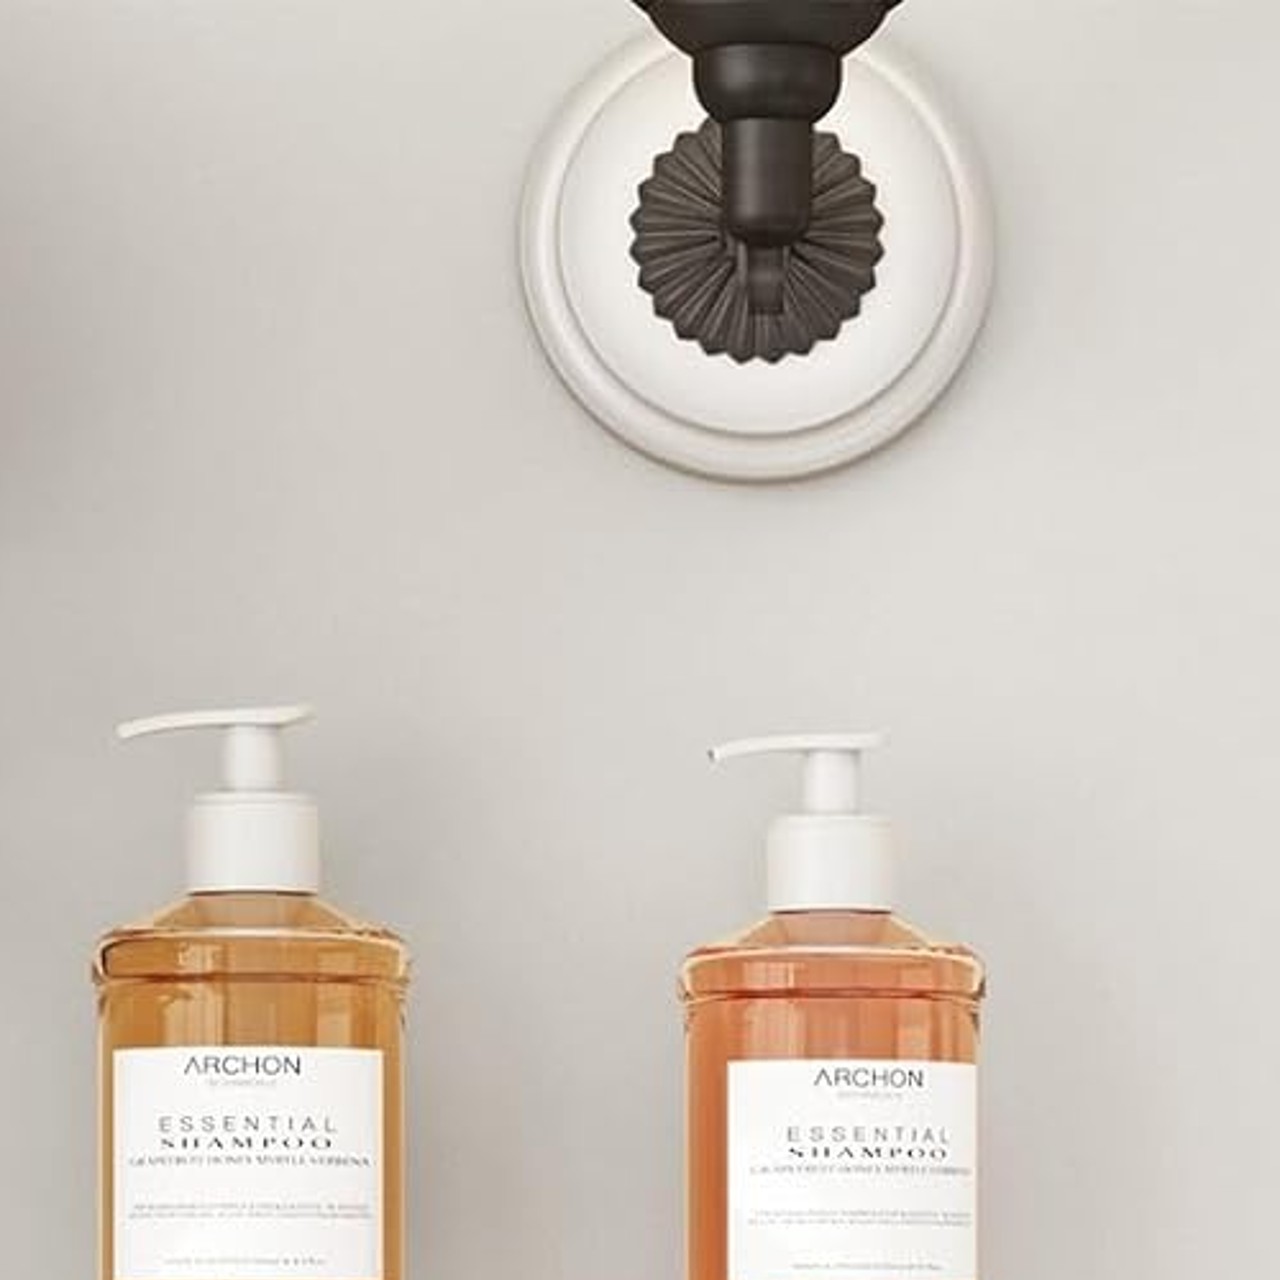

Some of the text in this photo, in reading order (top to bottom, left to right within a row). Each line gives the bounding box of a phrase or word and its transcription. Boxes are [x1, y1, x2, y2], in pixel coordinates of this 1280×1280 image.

[183, 1055, 302, 1076] ARCHON
[813, 1067, 924, 1088] ARCHON
[158, 1115, 337, 1133] ESSENTIAL
[160, 1136, 333, 1150] SHAMPOO
[786, 1126, 949, 1144] ESSENTIAL
[788, 1146, 948, 1160] SHAMPOO
